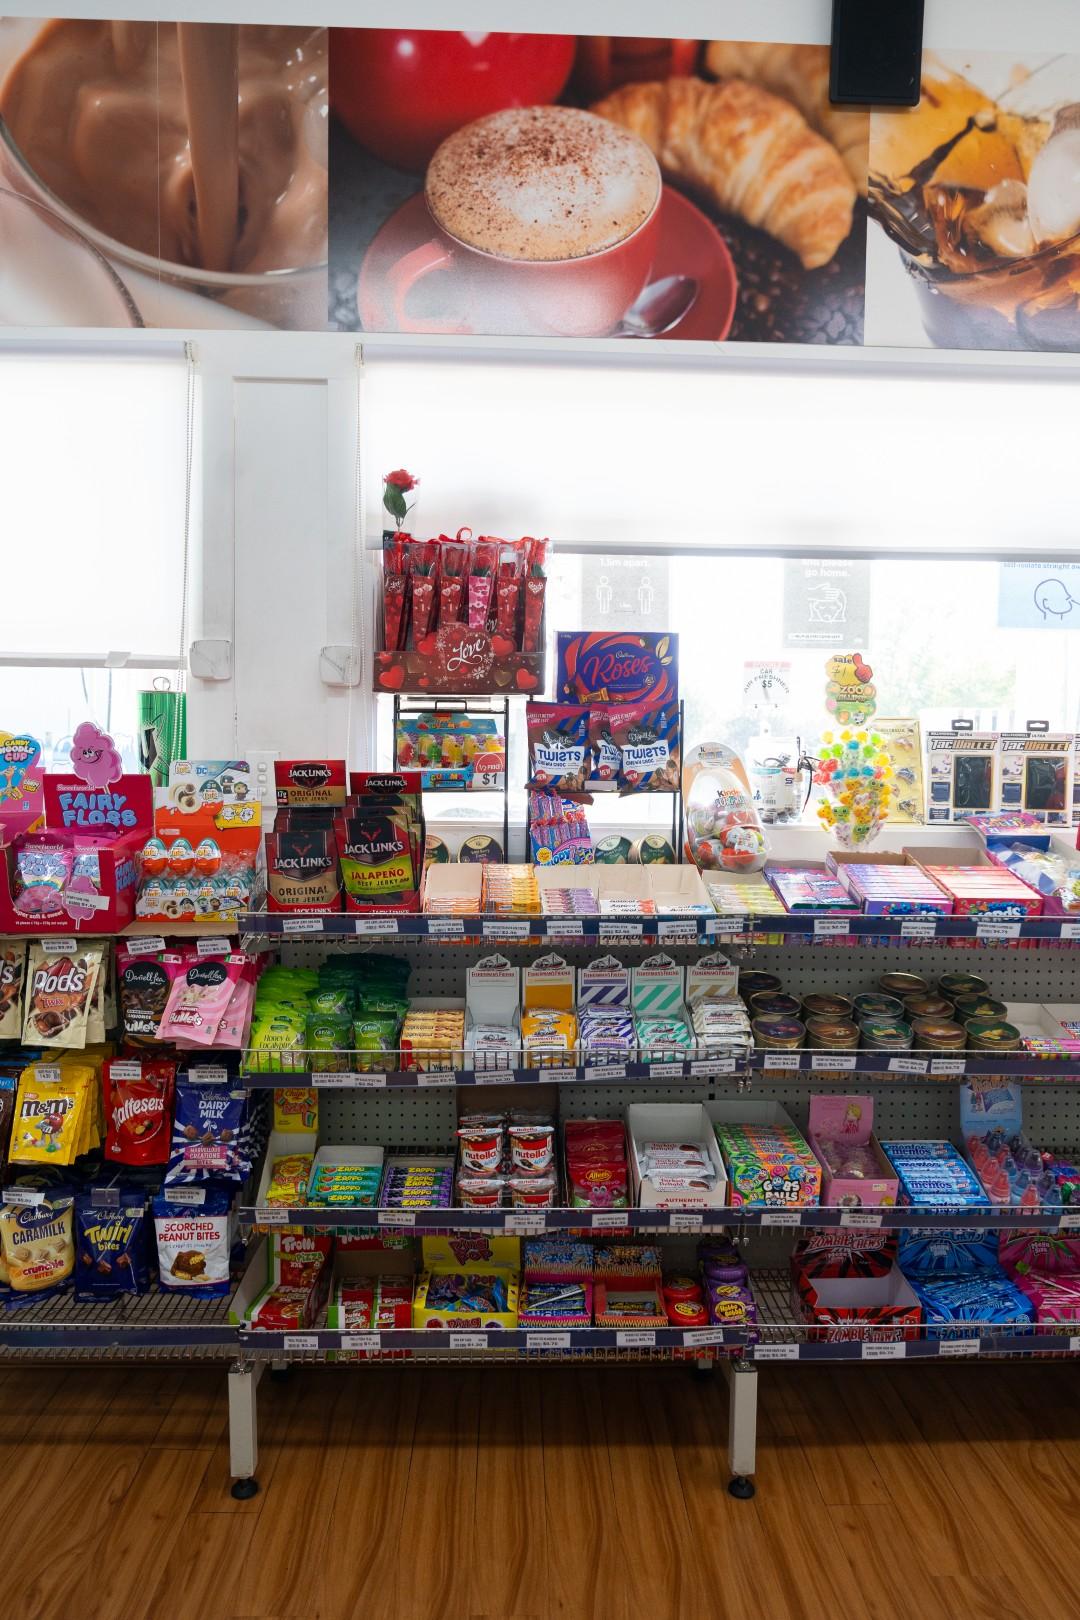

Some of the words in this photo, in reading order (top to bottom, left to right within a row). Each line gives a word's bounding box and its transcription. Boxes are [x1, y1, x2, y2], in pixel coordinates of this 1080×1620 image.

[446, 638, 486, 673] Love
[833, 655, 853, 664] sale
[583, 654, 655, 687] Roses
[761, 675, 773, 685] $5
[4, 752, 29, 762] CUP
[537, 748, 582, 762] TWISTS
[624, 746, 667, 760] TWISTS
[288, 768, 308, 778] JACK
[308, 768, 332, 777] LINK'S
[482, 773, 498, 785] $1
[364, 779, 385, 787] JACK
[384, 779, 408, 787] LINK'S
[58, 792, 127, 811] FAIRY
[62, 809, 138, 828] FLOSS
[344, 843, 372, 855] JACK
[372, 841, 405, 853] LINK'S
[273, 857, 300, 870] JACK
[300, 856, 332, 868] LINK'S
[351, 867, 405, 880] JALAPEÑO
[278, 886, 328, 897] ORIGINAL
[32, 967, 88, 997] Pods
[263, 1034, 285, 1043] Honey
[198, 1101, 231, 1111] DAIRY
[199, 1110, 225, 1120] MILK
[464, 1148, 497, 1160] nutella
[515, 1148, 547, 1160] nutella
[892, 1148, 932, 1157] mentos
[910, 1180, 953, 1190] mentos
[19, 1209, 54, 1225] Cadbury
[97, 1210, 126, 1222] Cadbury
[164, 1222, 214, 1232] SCORCHED
[12, 1222, 66, 1246] CARAMILK
[84, 1222, 132, 1245] Twirl
[158, 1232, 195, 1242] PEANUT
[196, 1231, 221, 1241] BITES
[98, 1243, 120, 1253] bites
[282, 1236, 316, 1252] Trolli
[807, 1235, 852, 1250] ZOMBIE
[23, 1258, 65, 1276] crunchie
